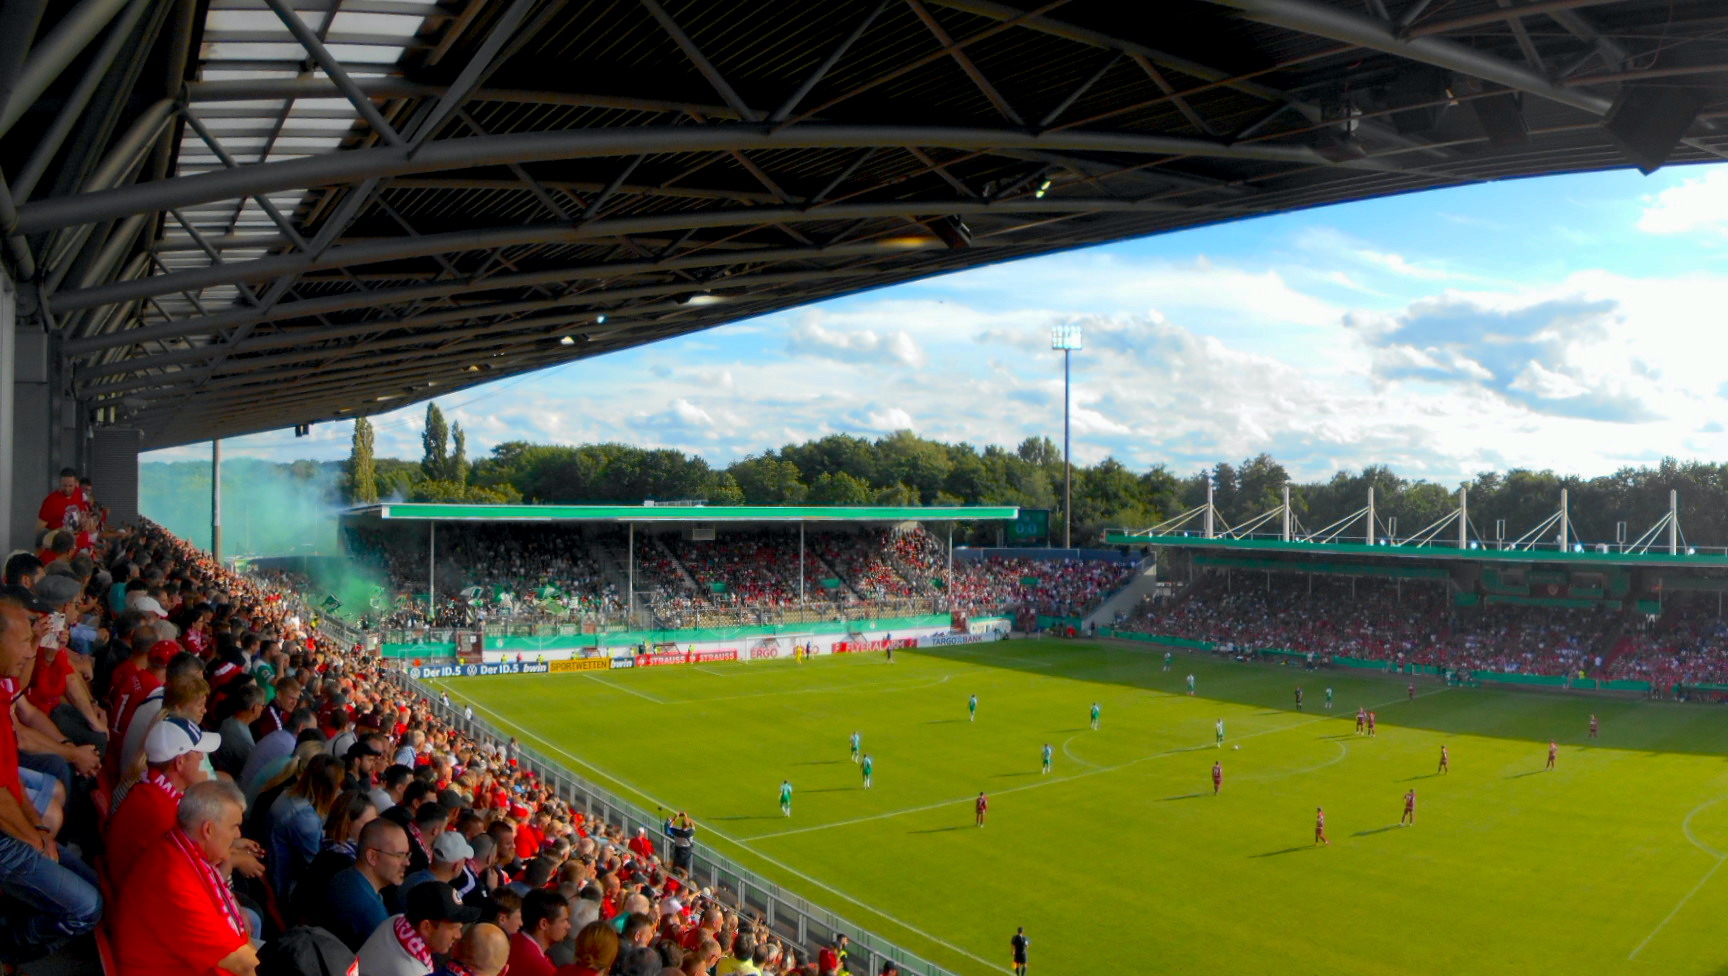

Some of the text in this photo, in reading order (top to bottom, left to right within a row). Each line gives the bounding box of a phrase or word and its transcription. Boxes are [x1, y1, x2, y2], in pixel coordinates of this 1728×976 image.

[699, 652, 735, 662] STRAUSS
[750, 647, 777, 659] ERGO
[523, 659, 633, 673] bwin SPORTWETTEN bwin
[649, 655, 686, 666] STRAUSS
[423, 666, 461, 678] Der ID.5
[480, 663, 519, 675] Der ID.5
